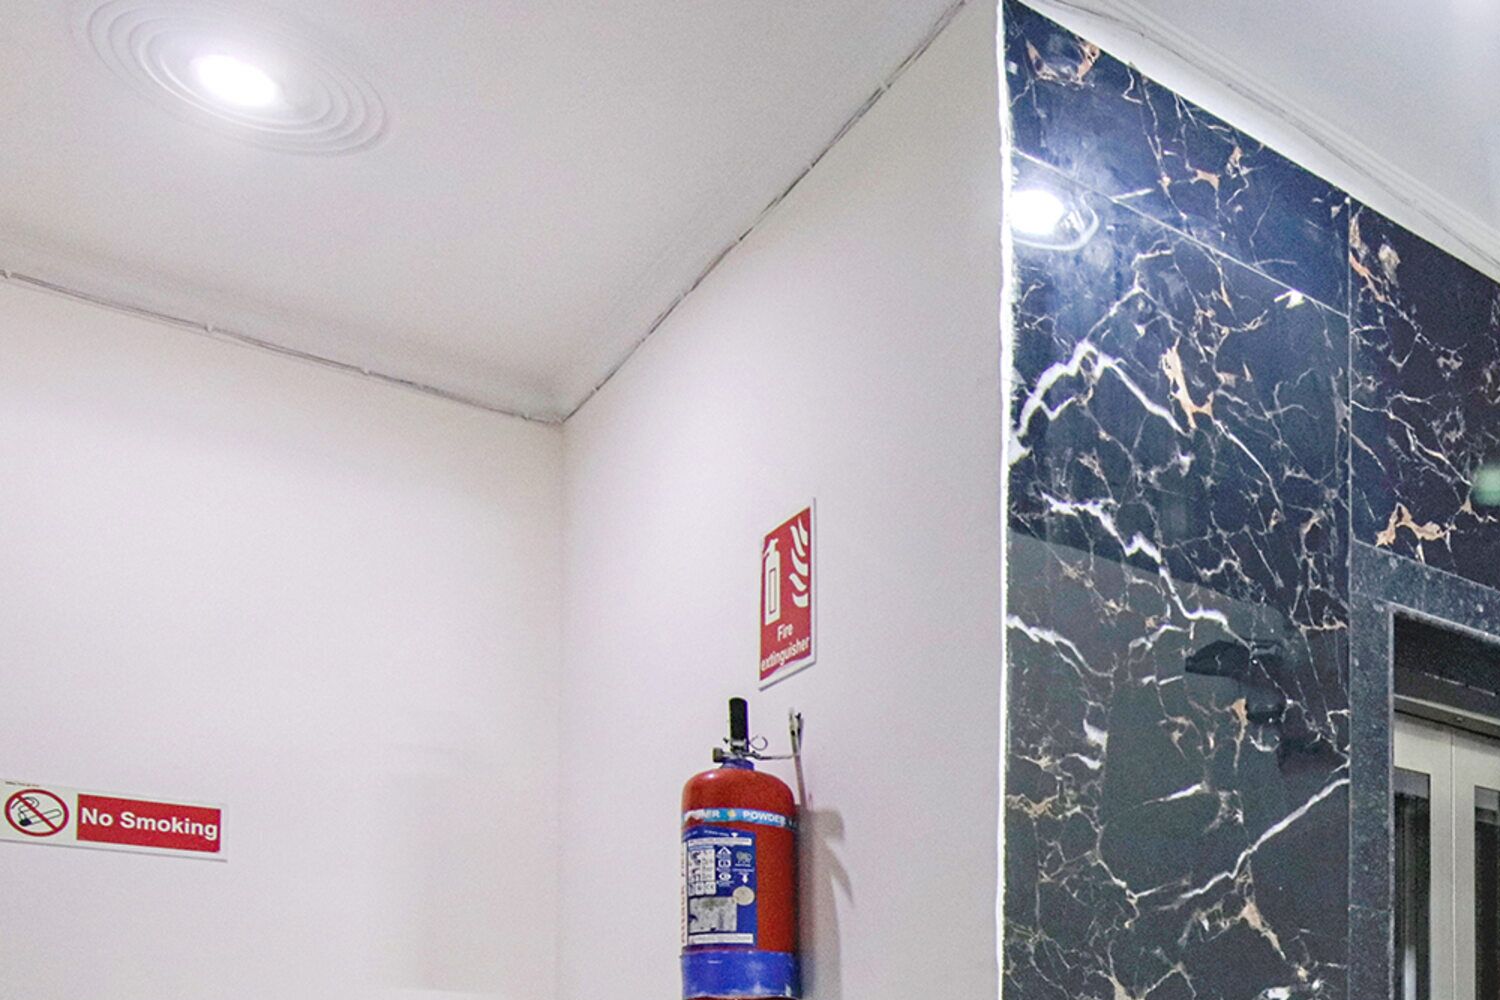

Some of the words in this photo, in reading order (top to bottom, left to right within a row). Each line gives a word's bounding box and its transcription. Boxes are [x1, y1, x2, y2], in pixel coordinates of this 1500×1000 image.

[777, 623, 794, 642] Fire
[761, 636, 810, 671] extinguisher
[80, 806, 114, 827] No
[119, 810, 218, 841] Smoking
